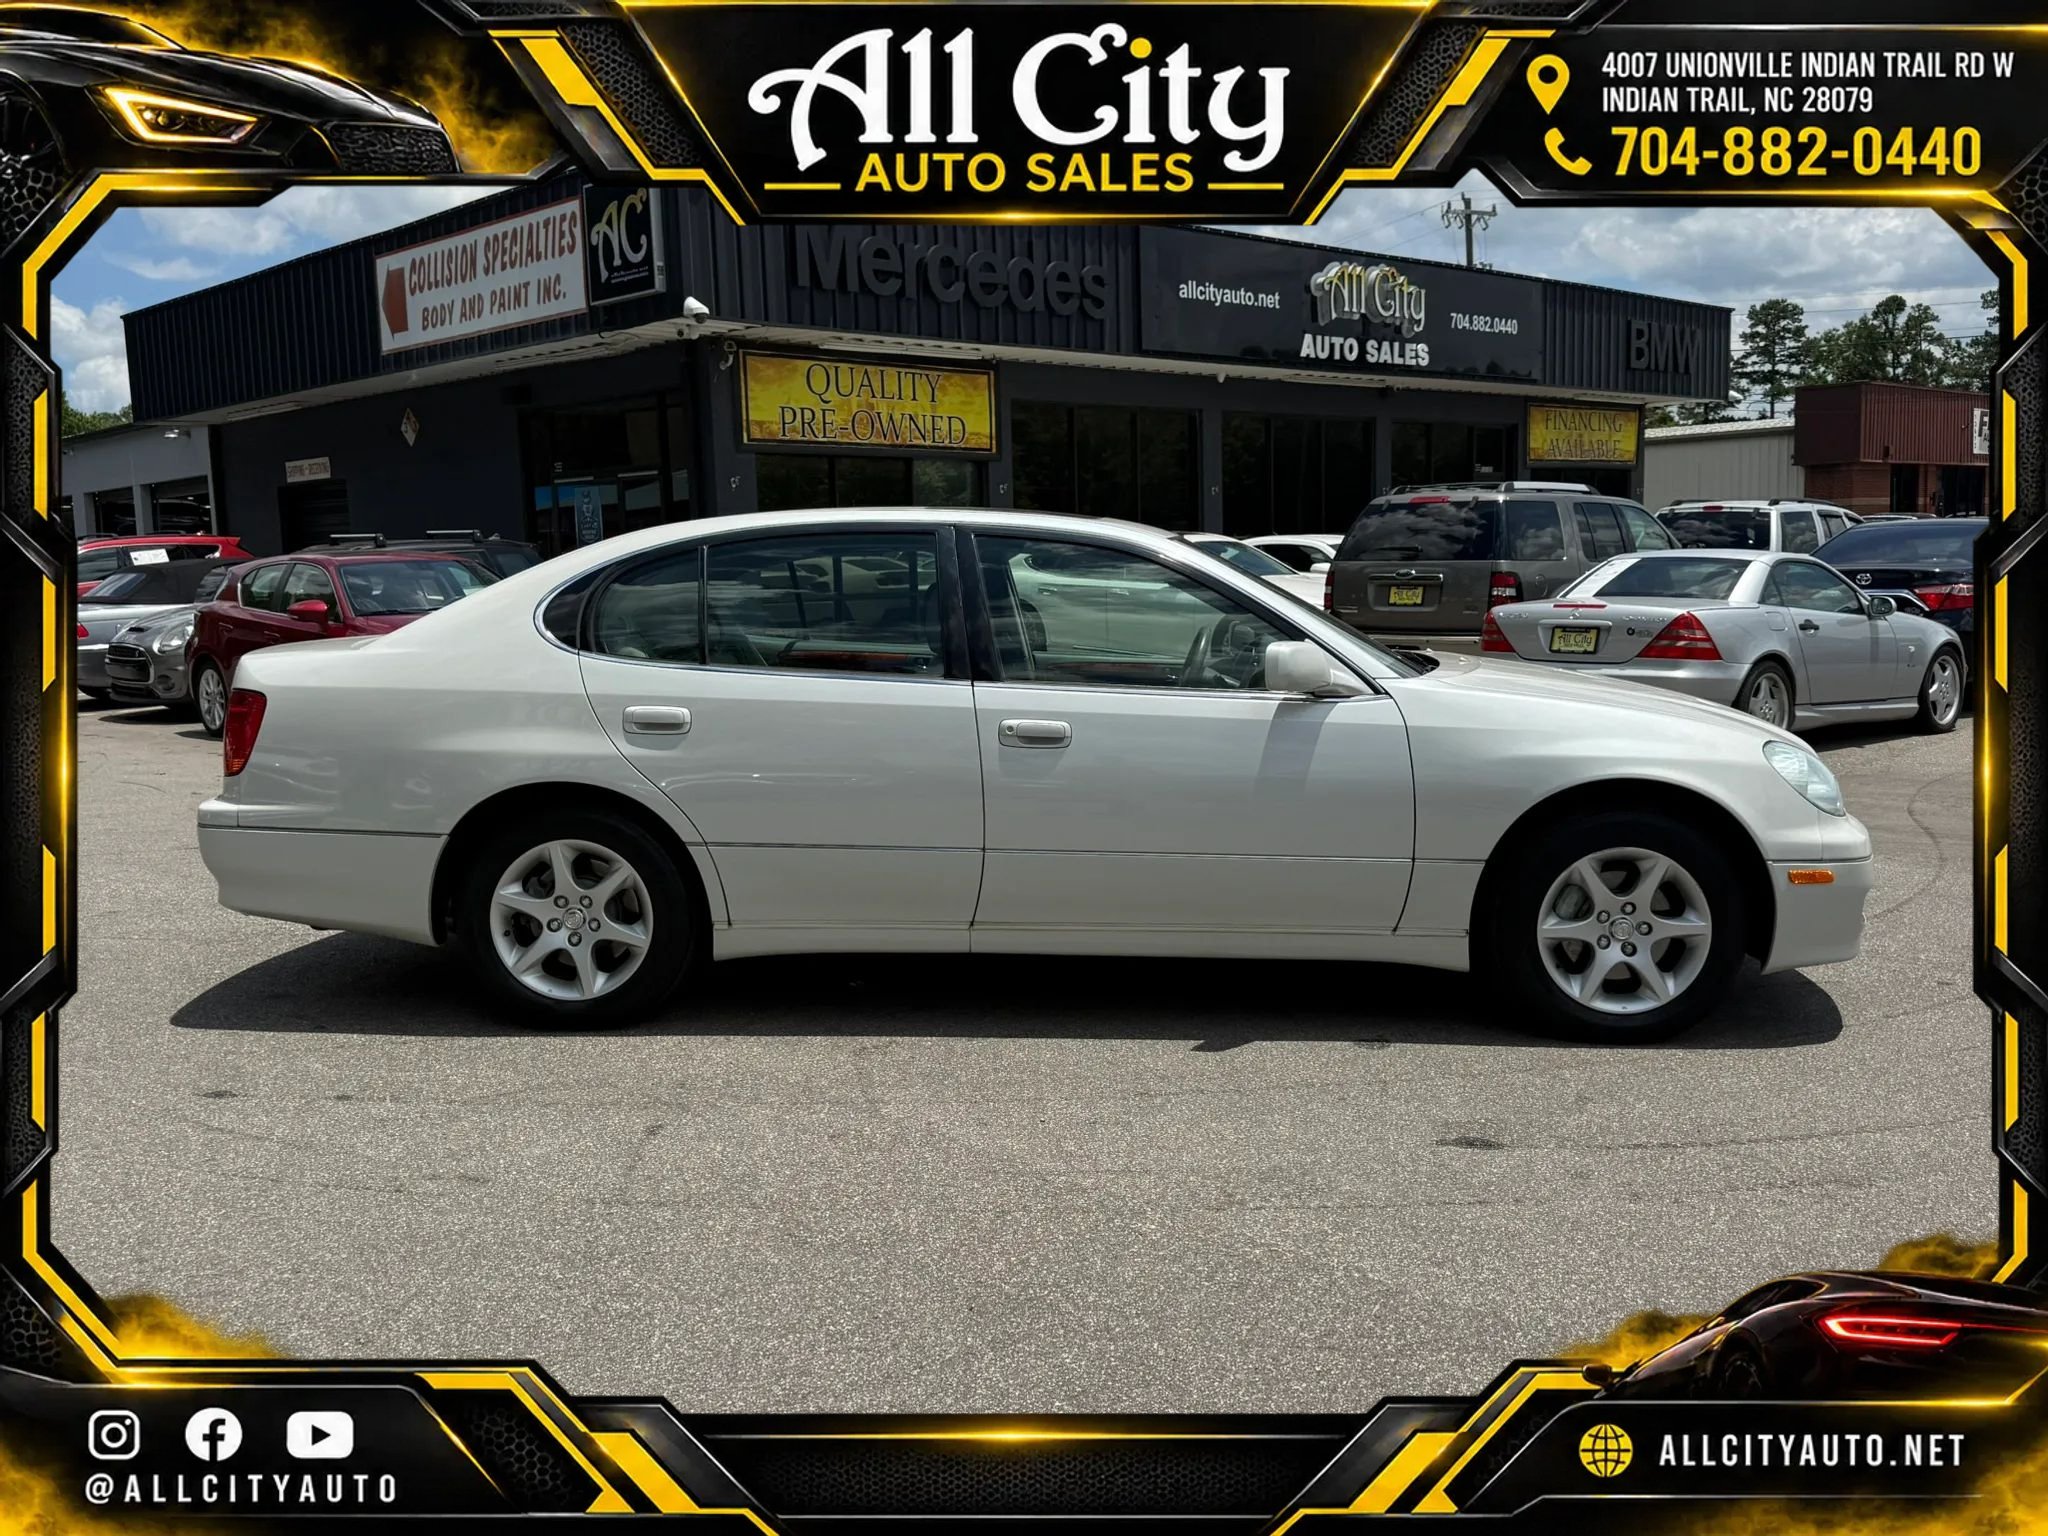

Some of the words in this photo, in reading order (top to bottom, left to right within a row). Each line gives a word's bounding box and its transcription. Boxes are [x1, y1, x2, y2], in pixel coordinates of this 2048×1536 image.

[409, 240, 477, 296] COLLISION
[483, 211, 577, 276] SPECIALTIES
[591, 187, 647, 283] AC
[797, 225, 1108, 320] Mercedes
[422, 300, 454, 331] BODY
[459, 293, 484, 324] AND
[490, 281, 531, 315] PAINT
[537, 274, 566, 308] INC.
[1179, 280, 1281, 309] allcityauto.net
[1313, 263, 1367, 325] All
[1369, 264, 1427, 334] City
[1450, 312, 1519, 335] 704.882.0440
[1300, 333, 1360, 362] AUTO
[1365, 338, 1430, 367] SALES
[1630, 319, 1700, 375] BMW
[805, 363, 943, 404] QUALITY
[779, 405, 967, 445] PRE-OWNED
[1544, 409, 1623, 433] FINANCING
[1546, 438, 1622, 459] AVAILABLE
